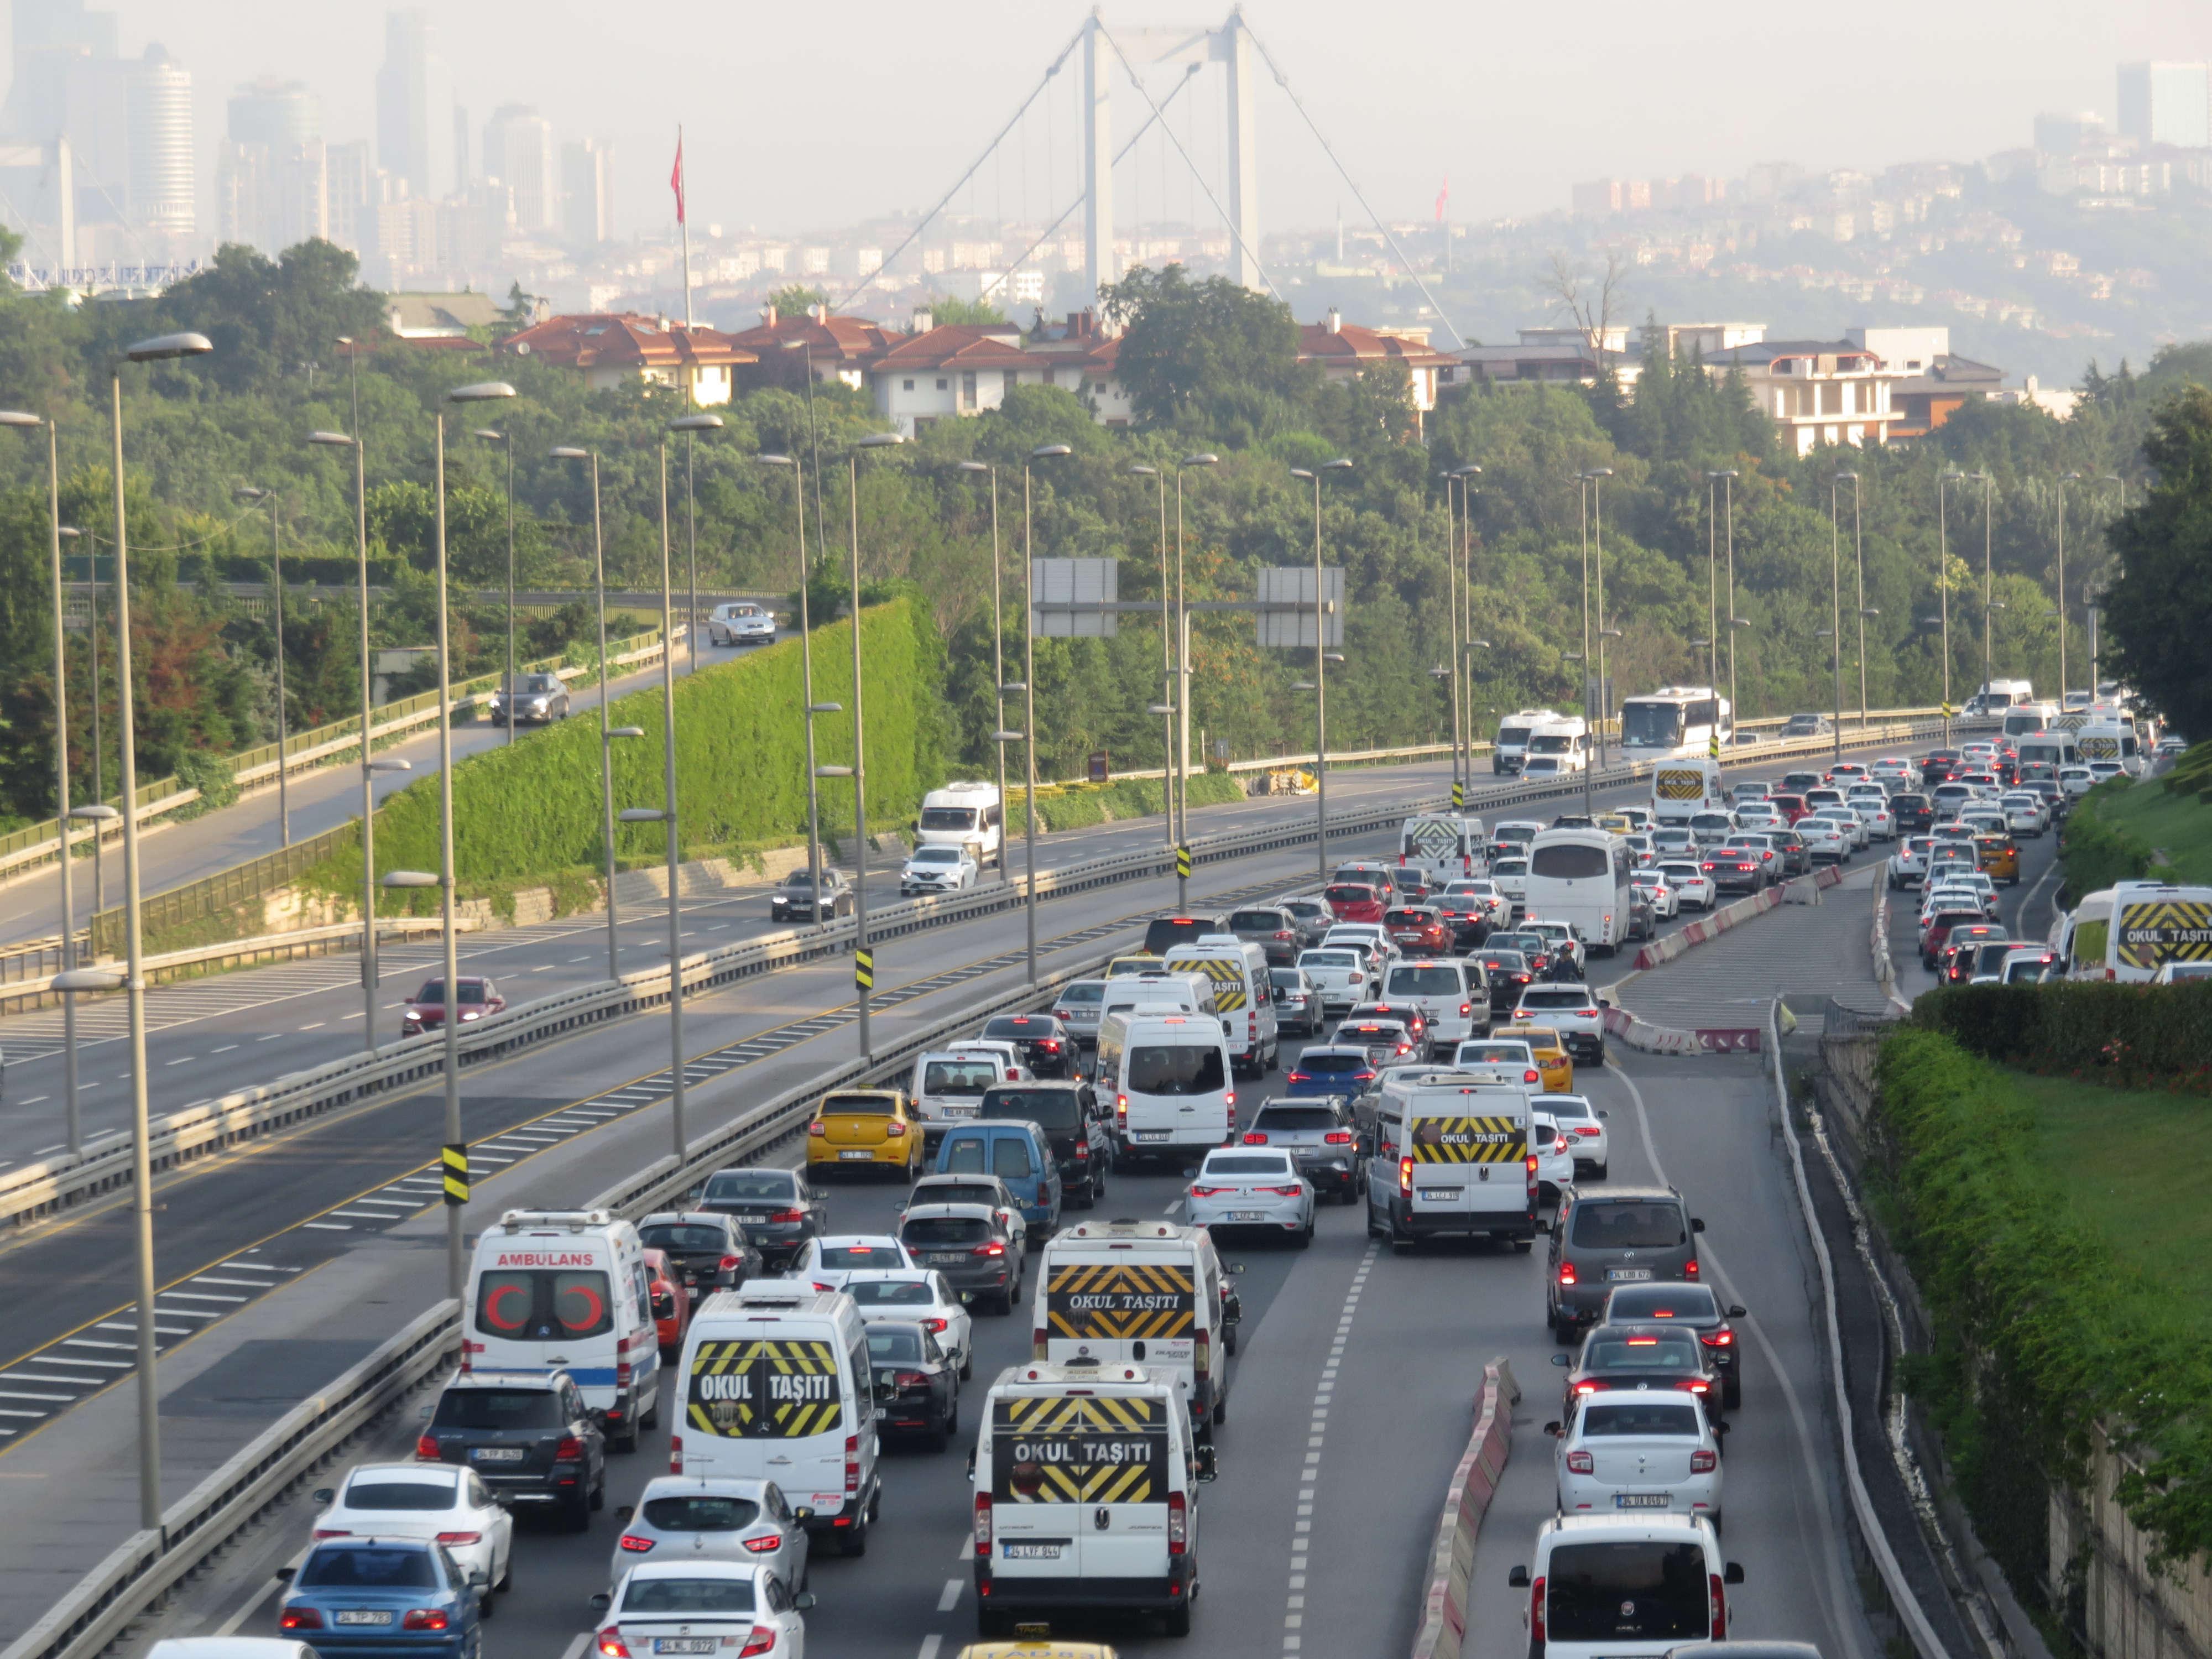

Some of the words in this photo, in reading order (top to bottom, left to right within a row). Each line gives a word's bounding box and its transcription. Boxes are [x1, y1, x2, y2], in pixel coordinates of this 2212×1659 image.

[2127, 930, 2162, 942] OKUL
[2171, 929, 2212, 945] TAŞITI
[1211, 982, 1241, 993] AŞITI
[1441, 1134, 1469, 1144] OKUL
[1475, 1134, 1507, 1145] TAŞITI
[498, 1253, 593, 1266] AMBULANS
[1070, 1295, 1115, 1310] OKUL
[1123, 1295, 1179, 1312] TAŞITI
[700, 1375, 752, 1400] OKUL
[770, 1375, 830, 1406] TAŞITI
[1015, 1444, 1074, 1462] OKUL
[1083, 1443, 1151, 1464] TAŞITI
